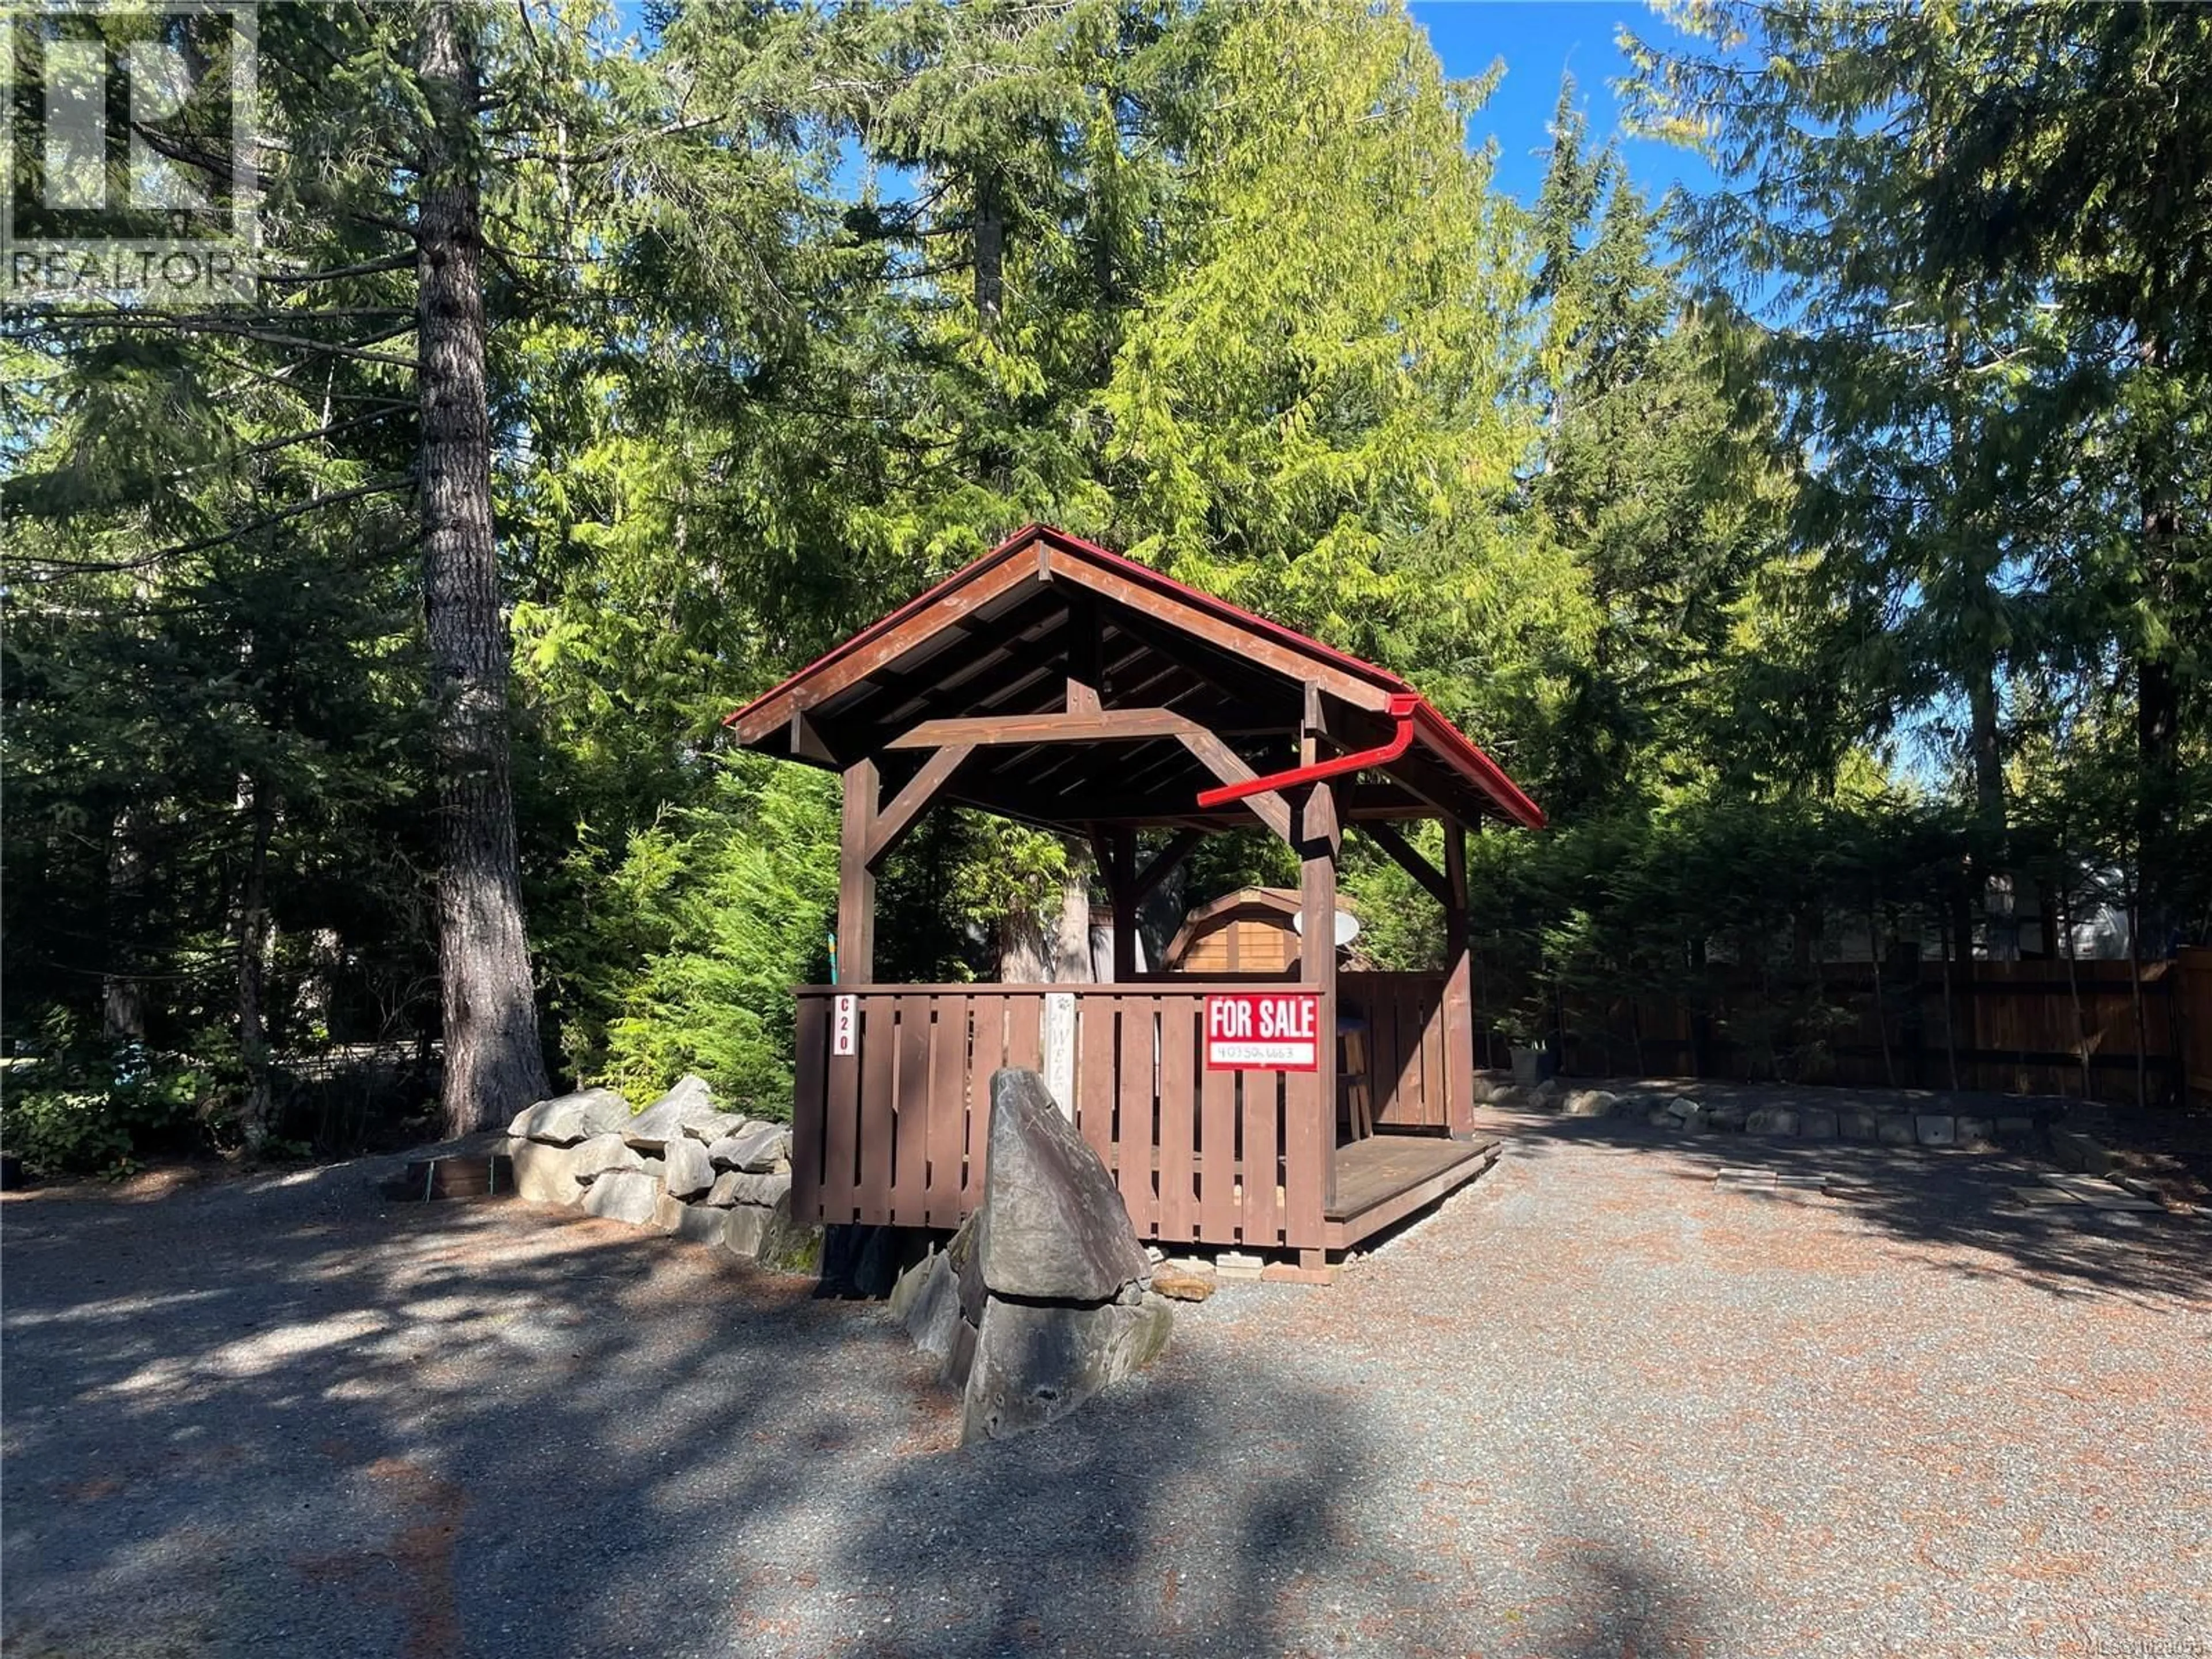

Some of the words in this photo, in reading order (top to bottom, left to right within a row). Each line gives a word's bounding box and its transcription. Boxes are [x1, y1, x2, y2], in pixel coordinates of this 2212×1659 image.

[840, 998, 849, 1050] C20
[1211, 1000, 1252, 1037] FOR
[1259, 1000, 1314, 1037] SALE
